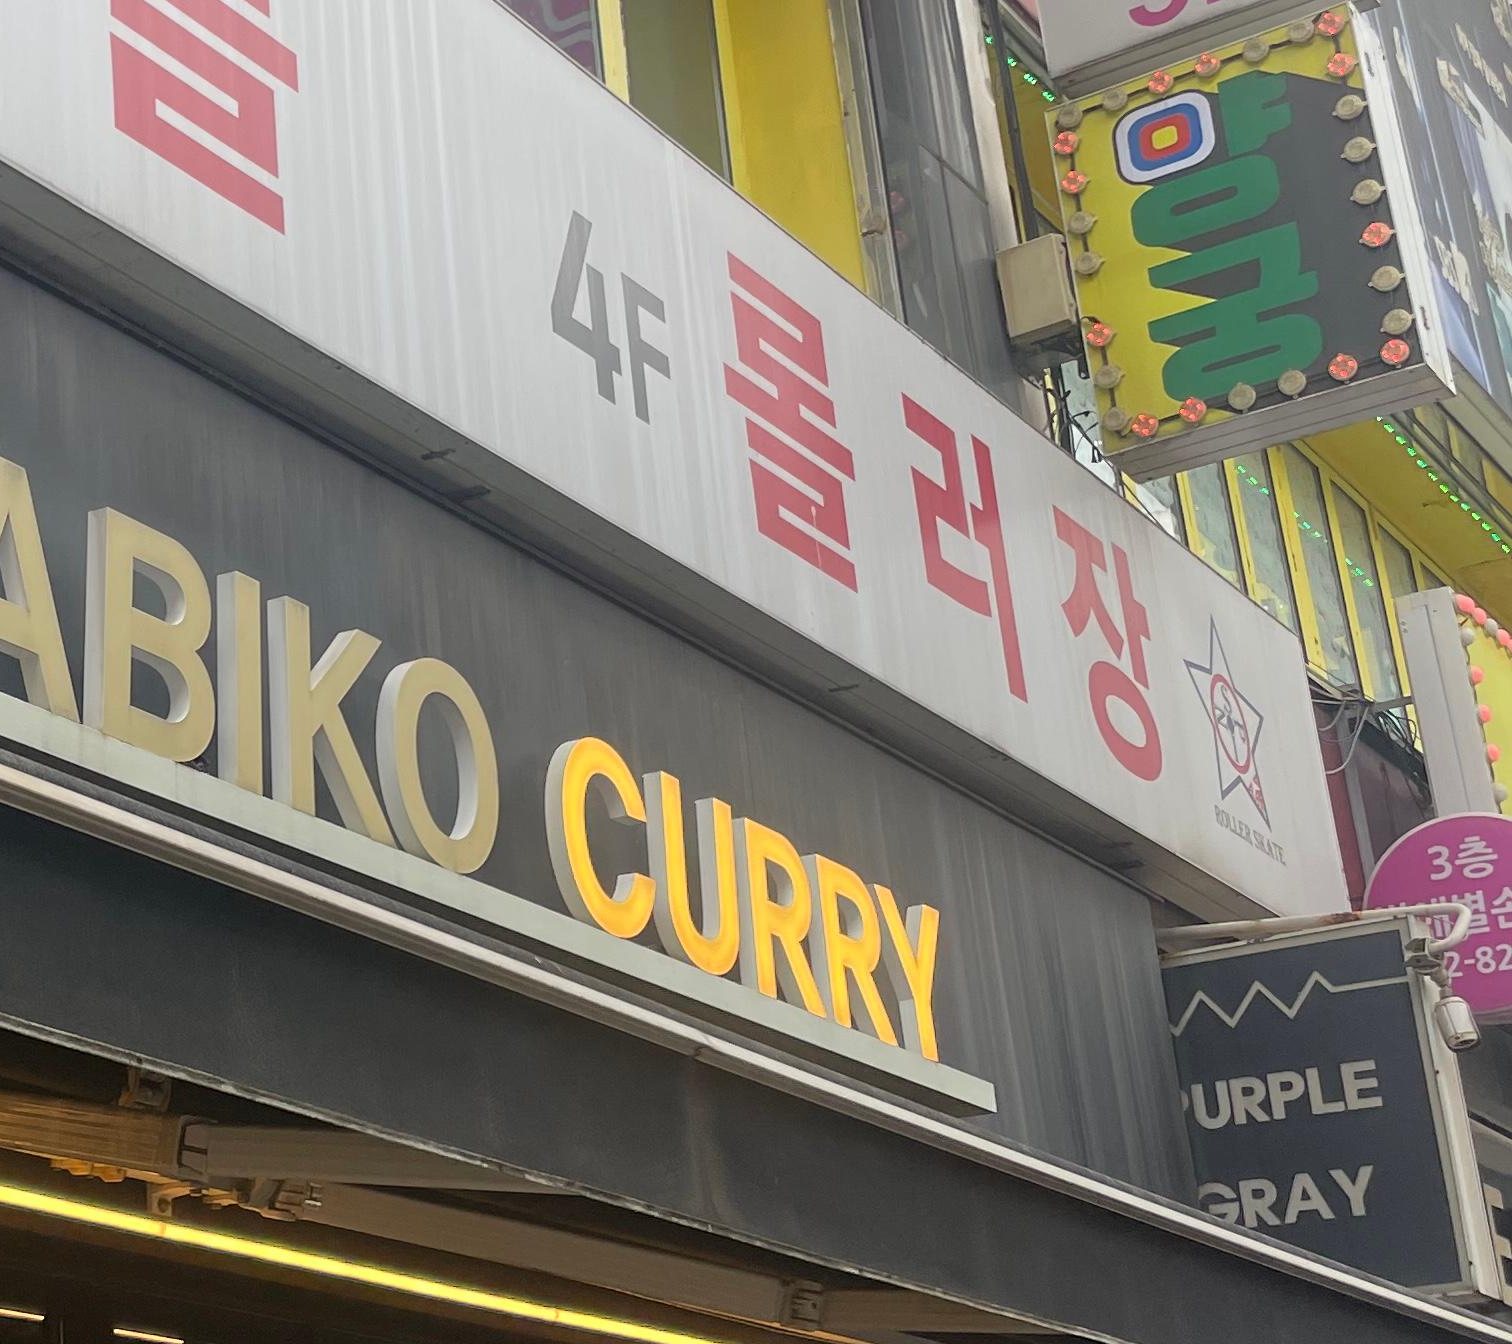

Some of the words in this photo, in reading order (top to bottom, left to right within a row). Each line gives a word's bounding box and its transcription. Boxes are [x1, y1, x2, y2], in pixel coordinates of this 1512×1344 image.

[551, 210, 672, 425] 4F
[723, 251, 1163, 782] 롤러장
[1214, 805, 1253, 848] ROLLER
[1252, 828, 1287, 867] SKATE
[1427, 835, 1499, 881] 3층
[545, 736, 939, 1061] CURRY
[1443, 943, 1512, 980] 2-82
[1181, 1058, 1384, 1131] URPLE
[1197, 1165, 1375, 1230] GRAY
